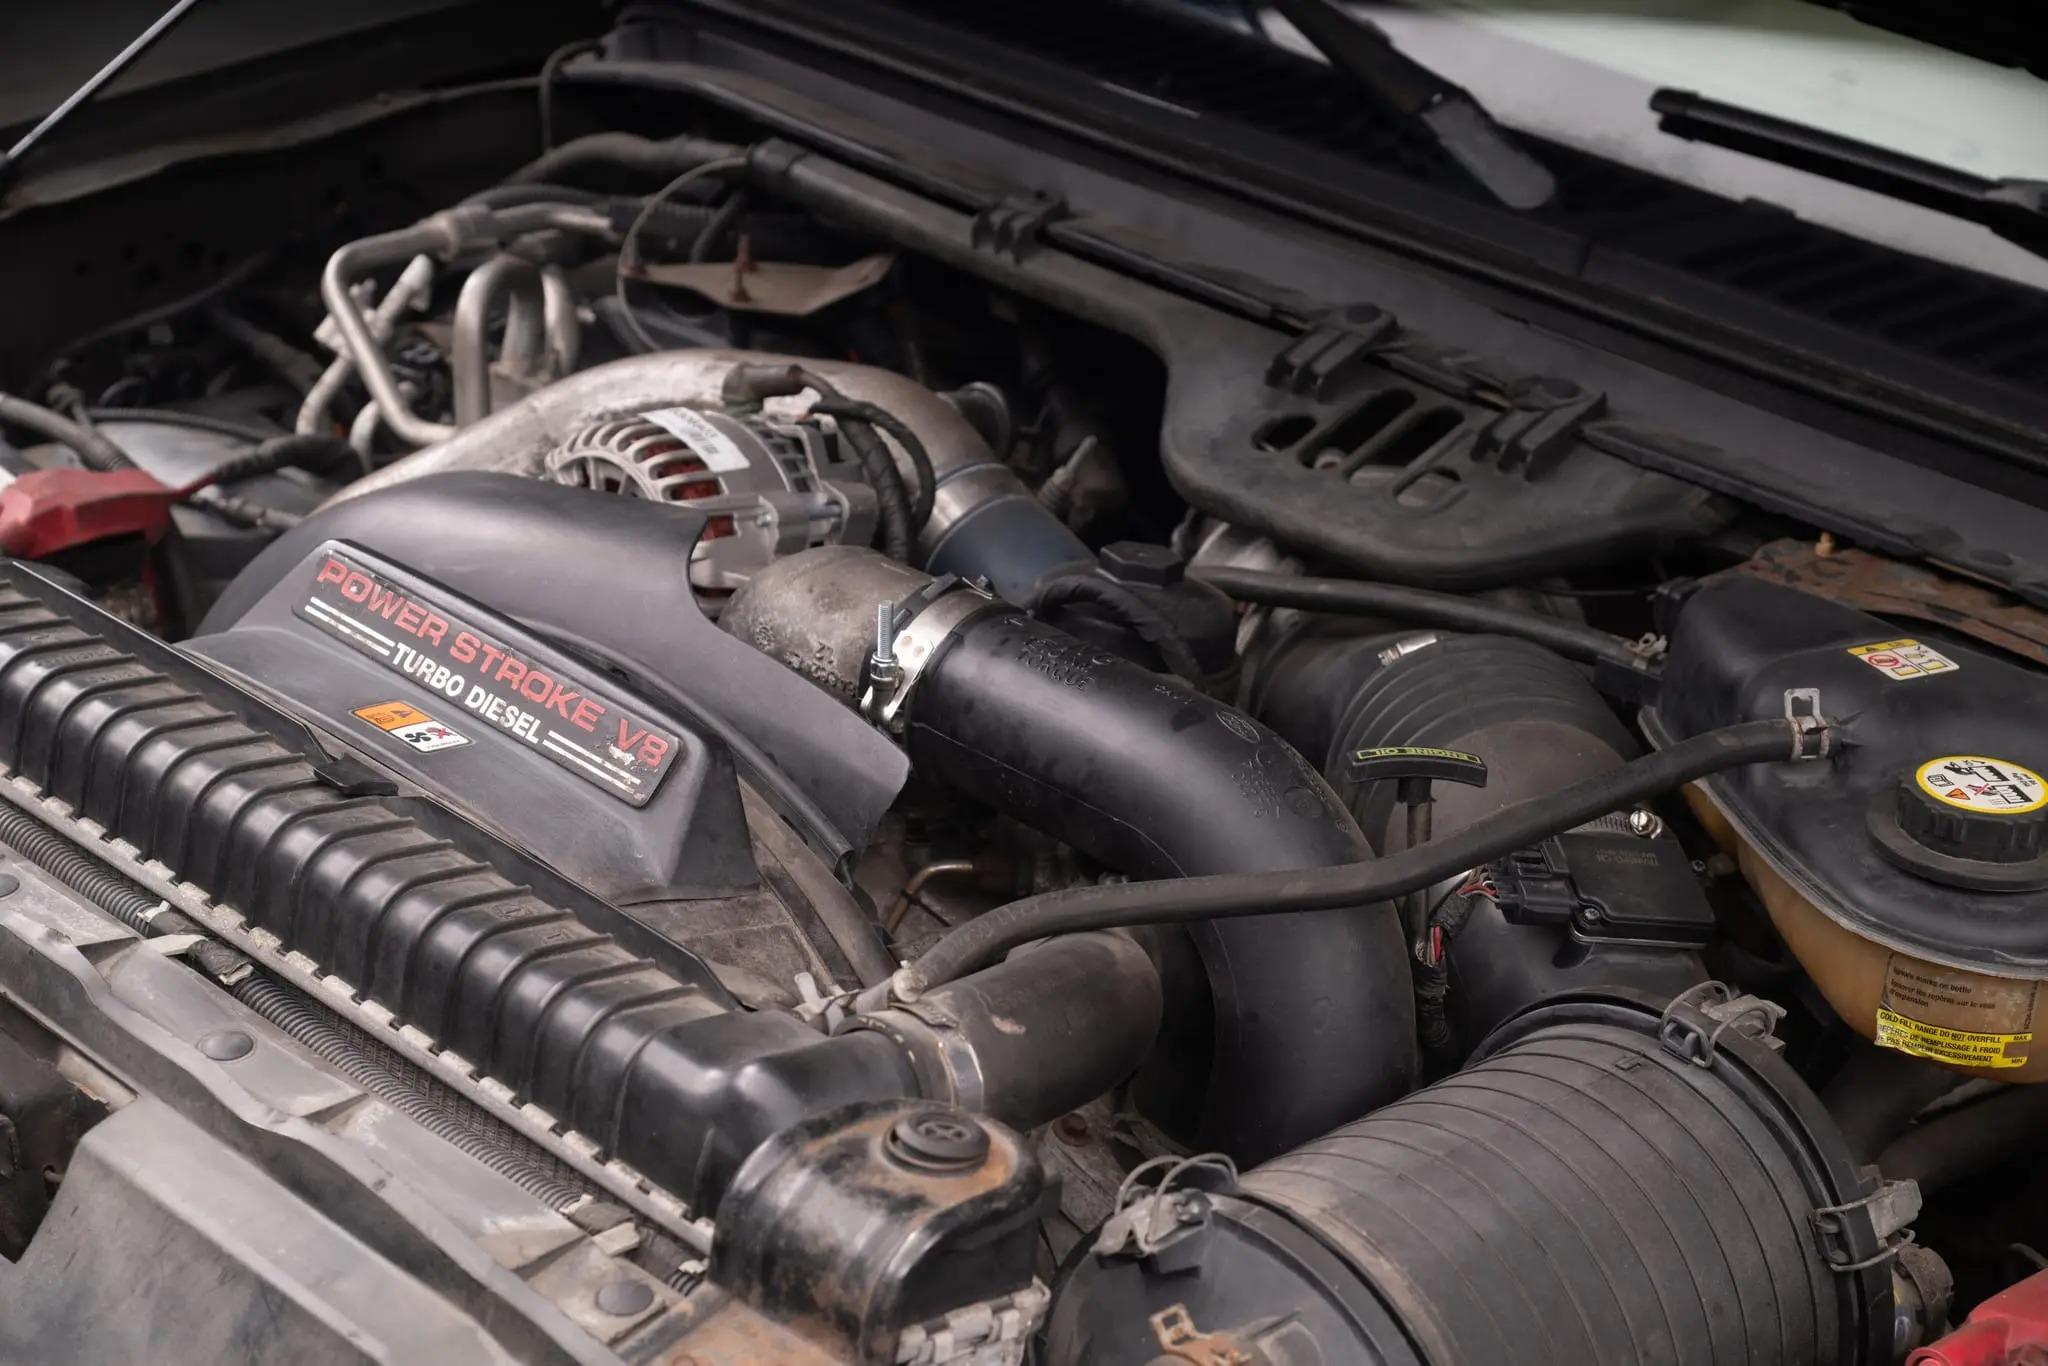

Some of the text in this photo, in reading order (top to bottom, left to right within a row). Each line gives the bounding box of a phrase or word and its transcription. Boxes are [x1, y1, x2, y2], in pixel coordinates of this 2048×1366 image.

[316, 559, 669, 767] POWER STROKE V8
[392, 642, 541, 744] TURBO DIESEL
[1372, 747, 1469, 760] ENGINE OIL
[1880, 1011, 2001, 1044] COLD FILL RANGE DO NOT OVERFILL
[1921, 1037, 1970, 1052] REMPLISSAGE
[1980, 1045, 2001, 1055] FROID
